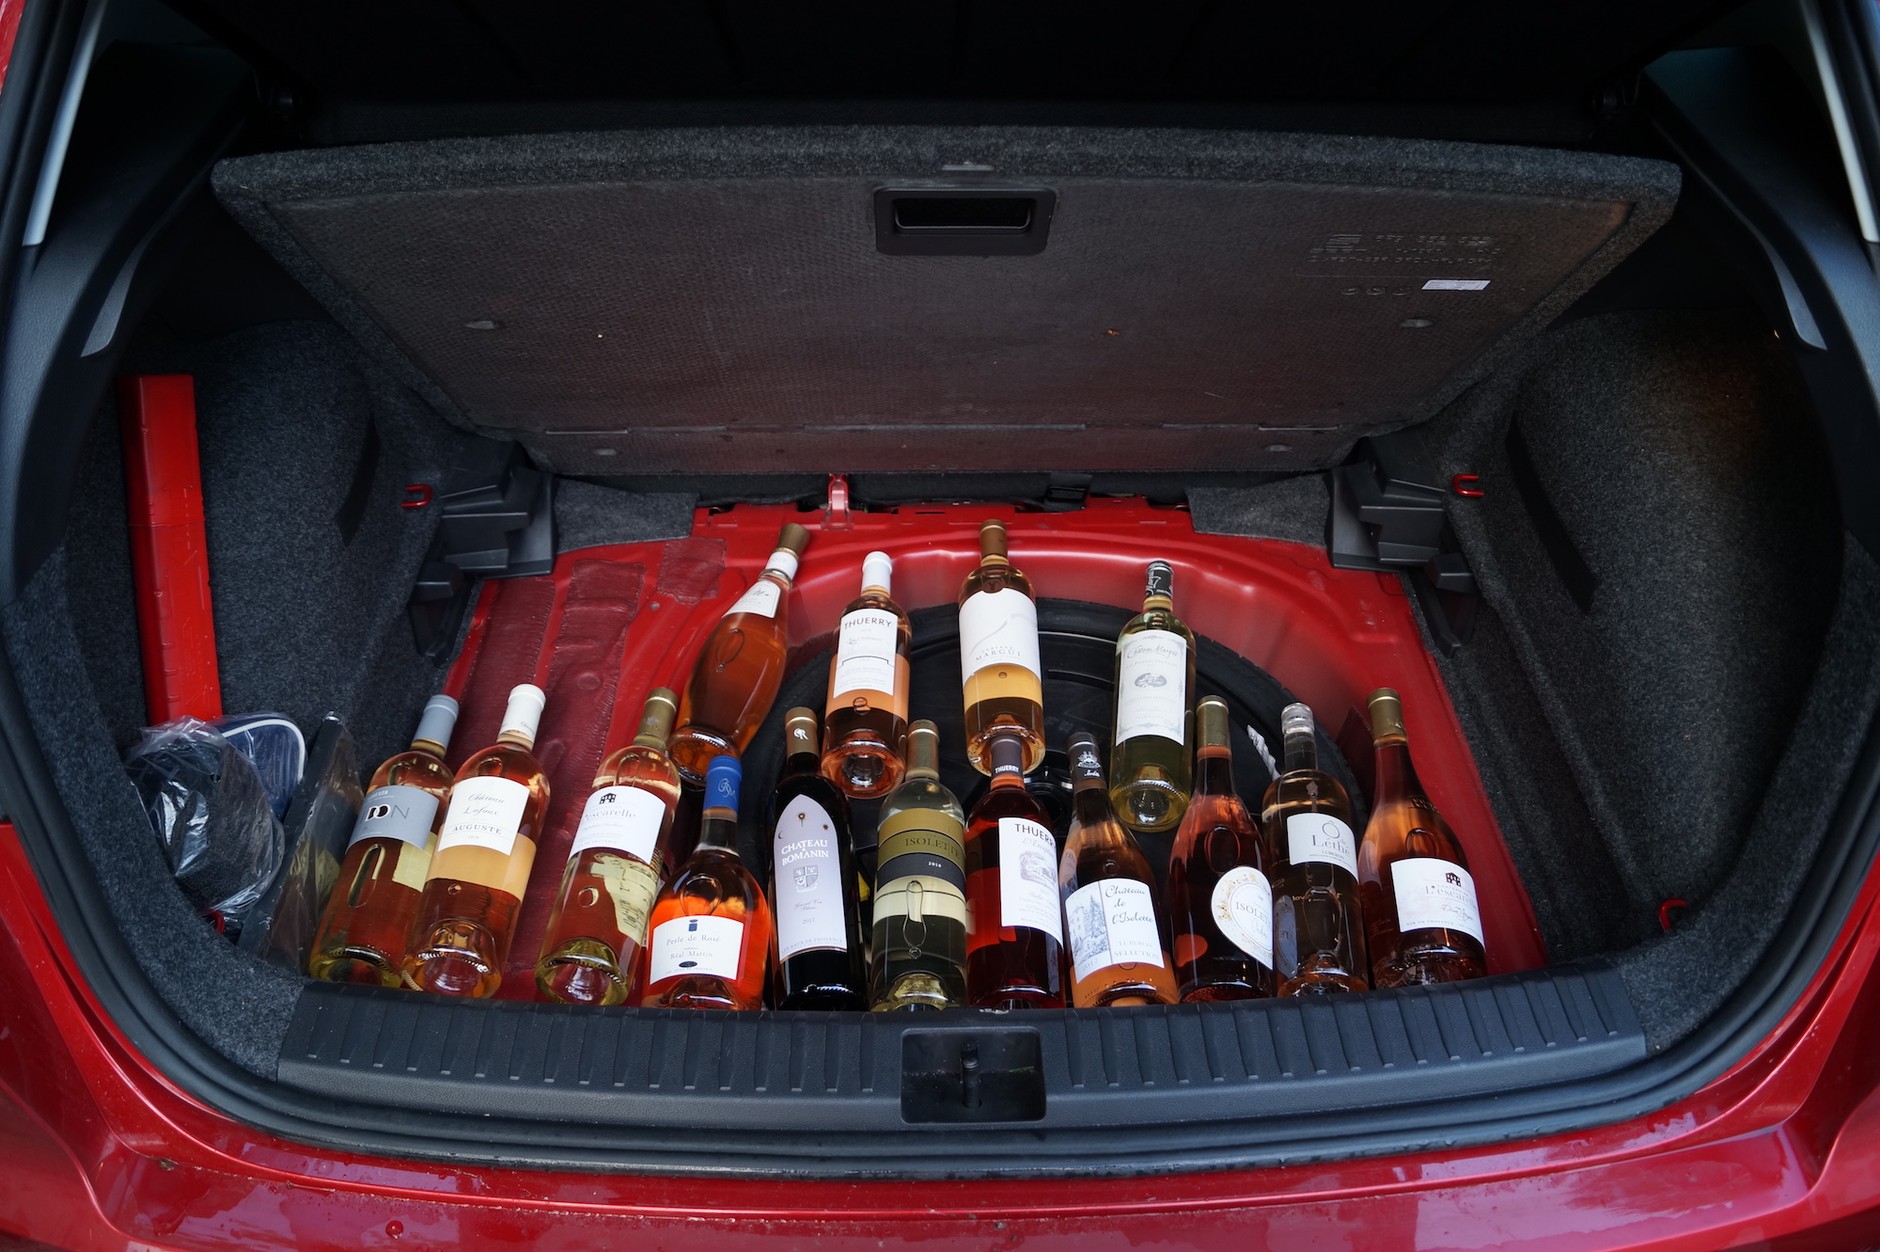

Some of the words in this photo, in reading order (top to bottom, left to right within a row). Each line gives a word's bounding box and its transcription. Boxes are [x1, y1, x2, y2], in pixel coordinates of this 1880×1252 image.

[845, 616, 892, 630] THUERRY
[995, 764, 1019, 774] THUERRY
[455, 823, 503, 836] AUGUSTE
[781, 838, 829, 856] CHATEAU
[905, 837, 961, 859] ISOLETTE
[781, 849, 830, 867] ROMANIN
[1105, 884, 1146, 899] Château
[1113, 897, 1128, 909] de
[665, 936, 685, 946] Perle
[687, 934, 698, 942] de
